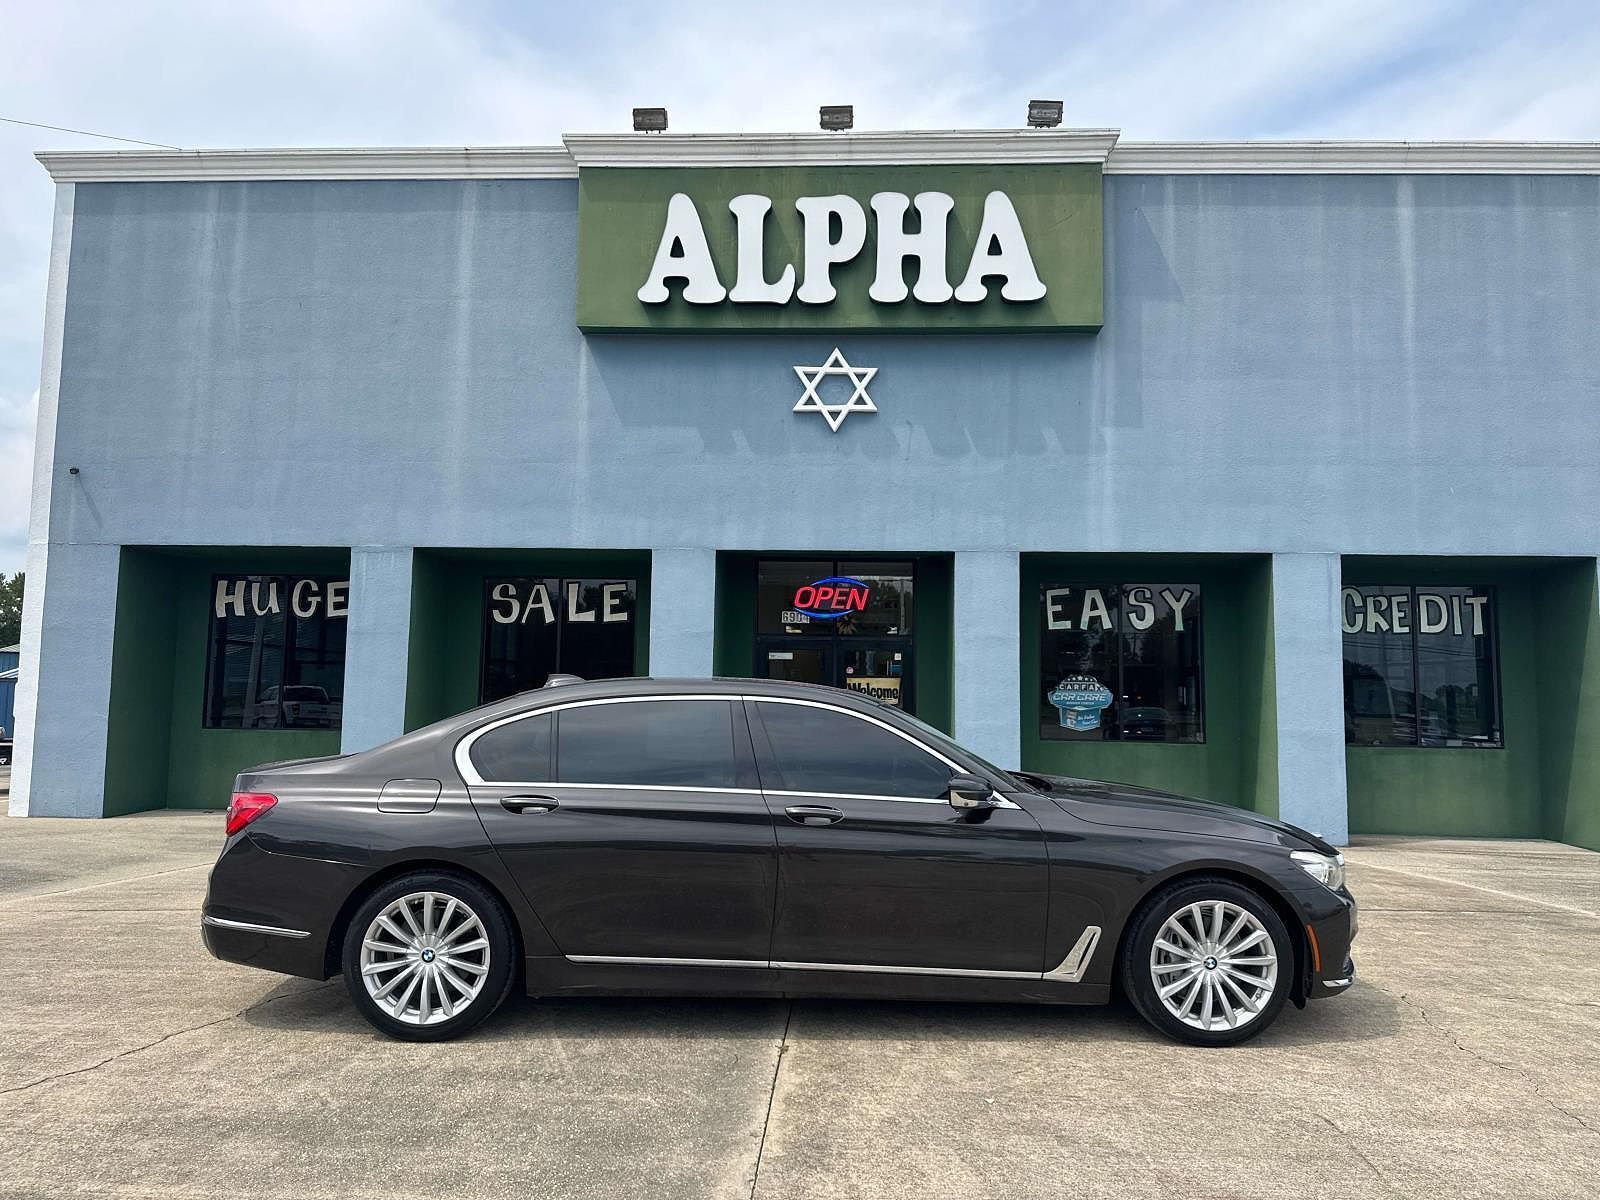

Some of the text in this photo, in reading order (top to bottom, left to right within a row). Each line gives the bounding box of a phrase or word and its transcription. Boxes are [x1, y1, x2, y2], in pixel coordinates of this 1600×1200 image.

[637, 190, 1047, 305] ALPHA
[215, 579, 349, 618] HUGE
[491, 581, 628, 624] SALE
[794, 587, 869, 610] OPEN
[1046, 586, 1194, 632] EASY
[1341, 586, 1488, 636] CREDIT
[1077, 693, 1106, 701] CARE
